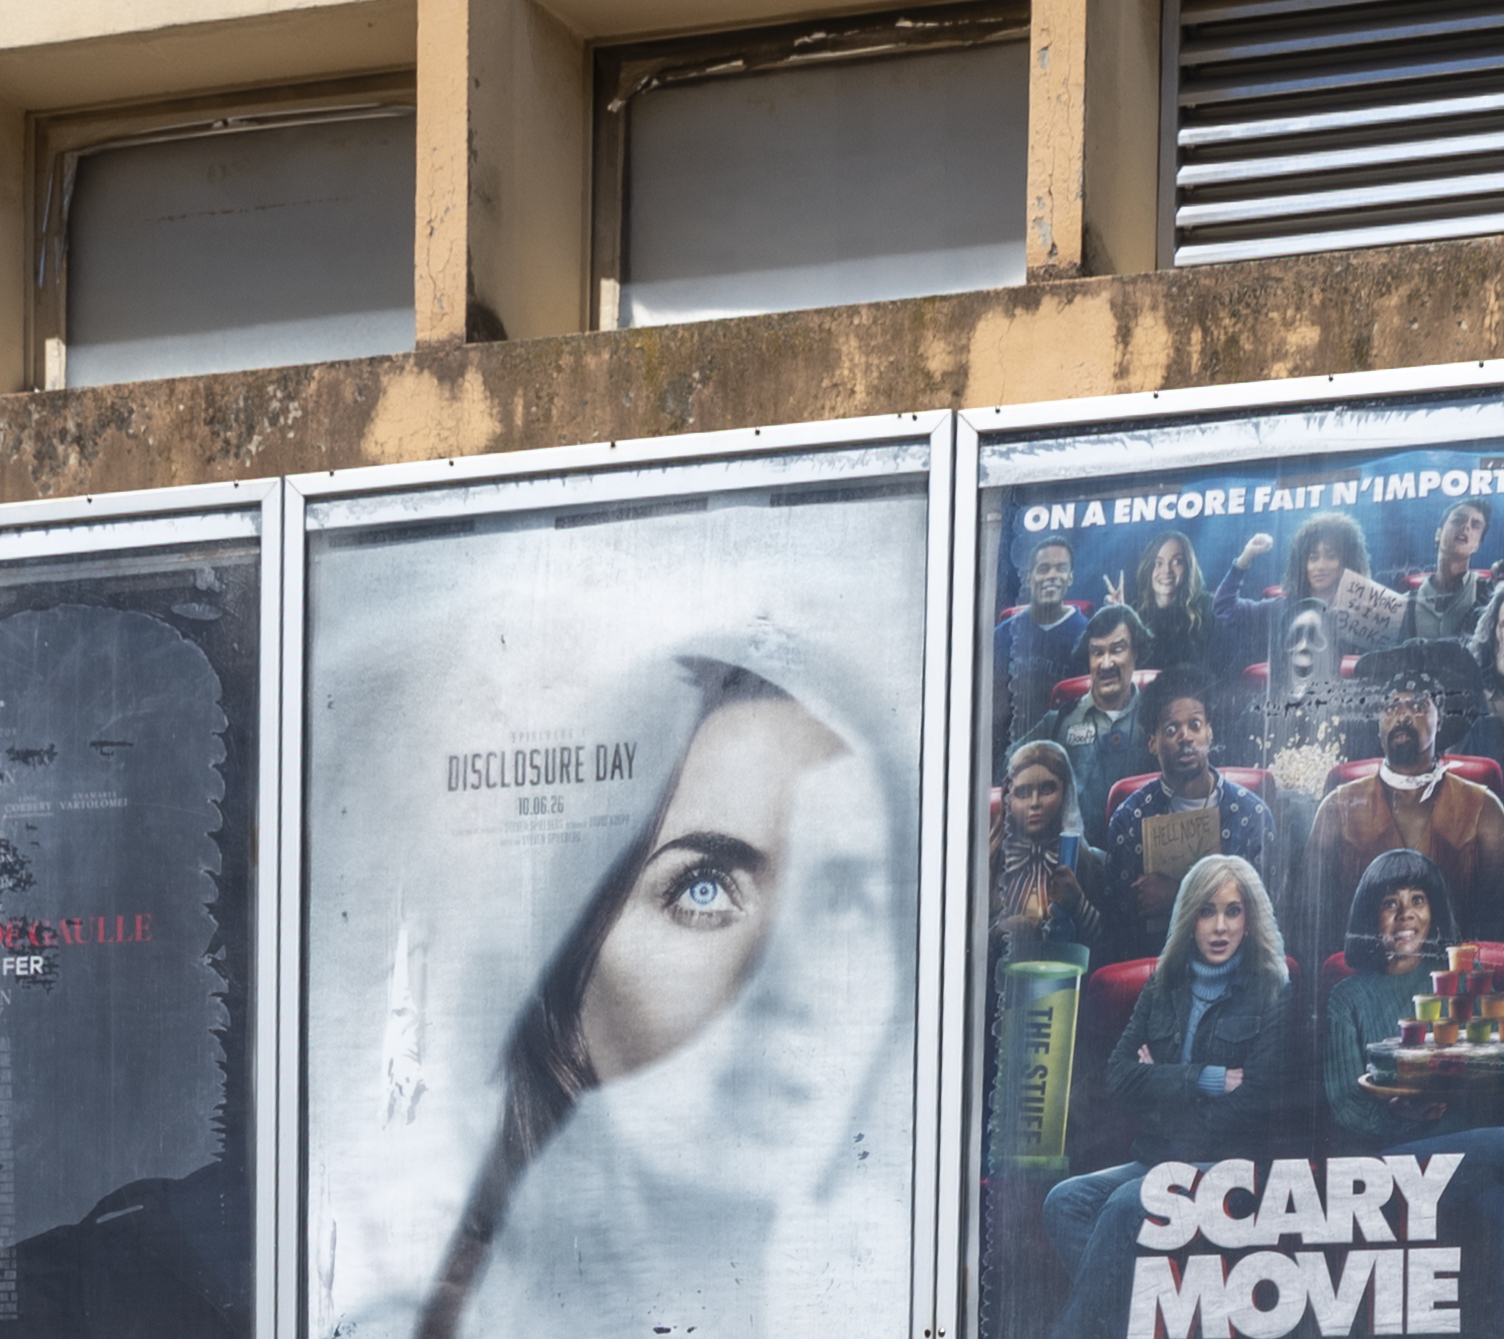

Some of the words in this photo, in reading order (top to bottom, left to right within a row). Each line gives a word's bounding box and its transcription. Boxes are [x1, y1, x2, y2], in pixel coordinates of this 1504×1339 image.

[1024, 505, 1074, 532] ON
[1081, 502, 1106, 527] A
[1114, 489, 1246, 525] ENCORE
[1255, 484, 1321, 514] FAIT
[448, 746, 585, 792] DISCLOSURE
[595, 741, 638, 781] DAY
[518, 796, 564, 815] 10.06.26
[29, 914, 153, 947] GAULLE
[3, 956, 45, 976] FER
[1026, 1006, 1053, 1057] THE
[1020, 1063, 1049, 1146] STUFF
[1136, 1153, 1465, 1250] SCARY
